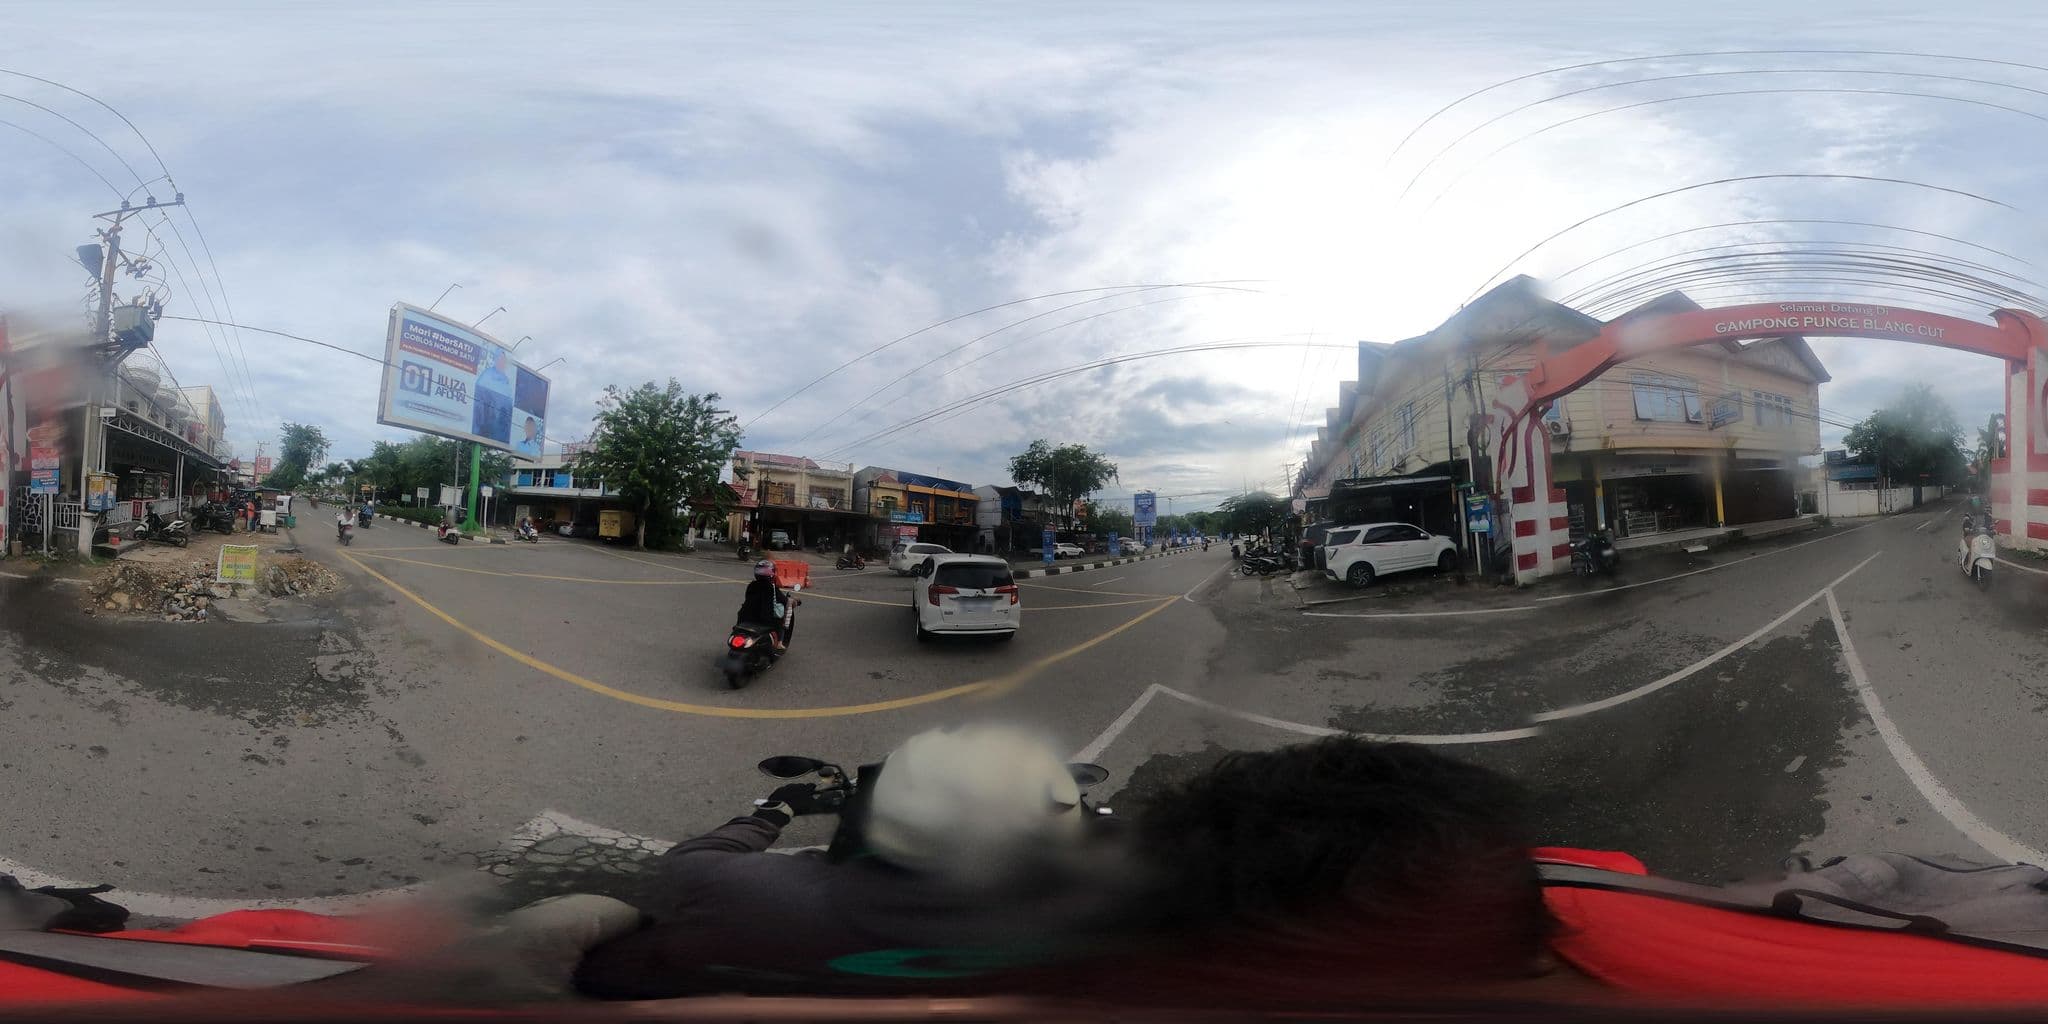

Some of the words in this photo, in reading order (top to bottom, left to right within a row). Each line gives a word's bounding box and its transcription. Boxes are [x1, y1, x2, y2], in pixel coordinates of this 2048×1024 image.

[1779, 302, 1827, 313] Selamat
[1830, 303, 1873, 317] Datang
[1876, 305, 1889, 315] Di
[409, 324, 431, 337] Mari
[432, 332, 474, 353] #berSATU
[1715, 316, 1799, 334] GAMPONG
[1803, 316, 1860, 330] PUNGE
[1863, 319, 1915, 335] BLANG
[1919, 324, 1945, 339] CUT
[403, 332, 433, 347] COBLOS
[434, 342, 459, 355] NOMOR
[459, 351, 475, 362] SATU
[405, 365, 430, 393] 01
